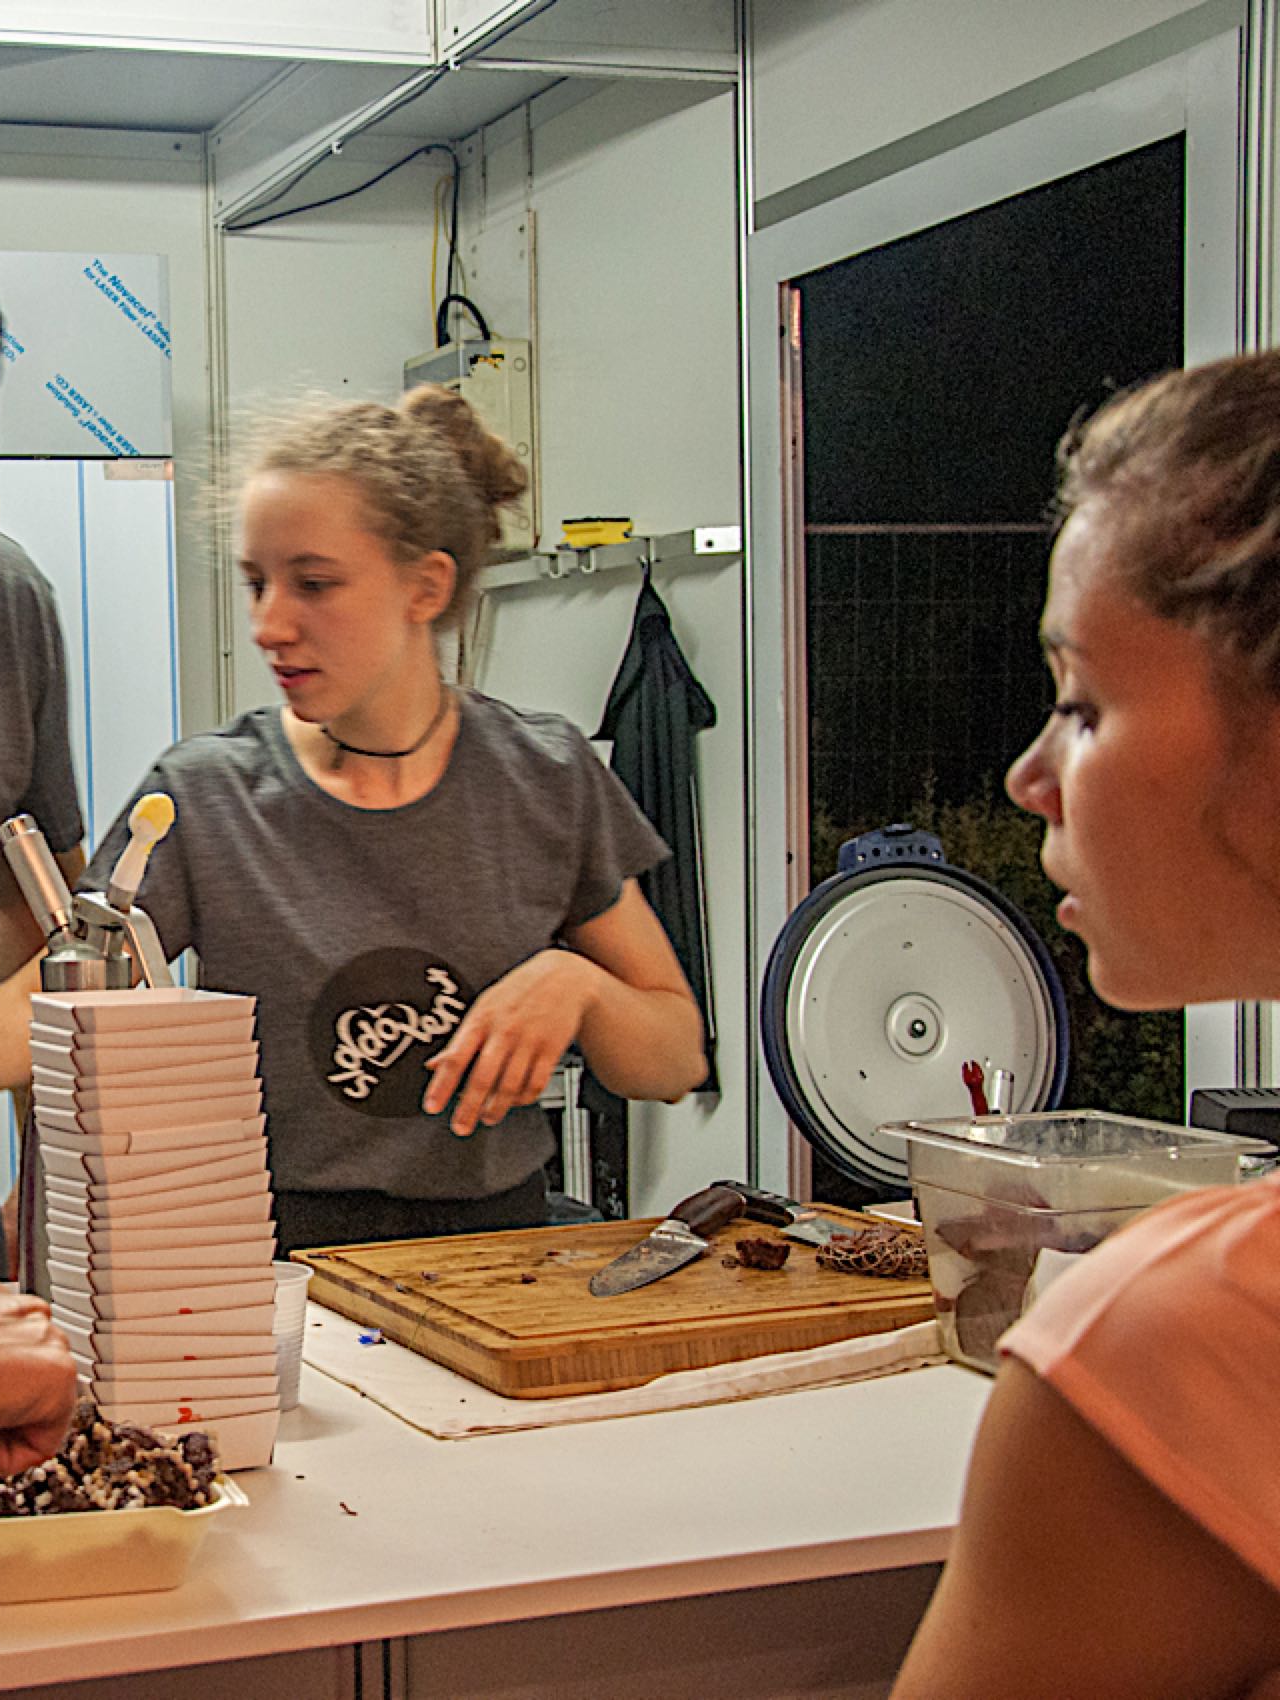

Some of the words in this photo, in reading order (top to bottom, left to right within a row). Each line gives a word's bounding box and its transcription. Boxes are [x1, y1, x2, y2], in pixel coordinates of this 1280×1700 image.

[93, 259, 108, 277] The
[83, 267, 95, 280] for
[95, 279, 119, 304] LASER
